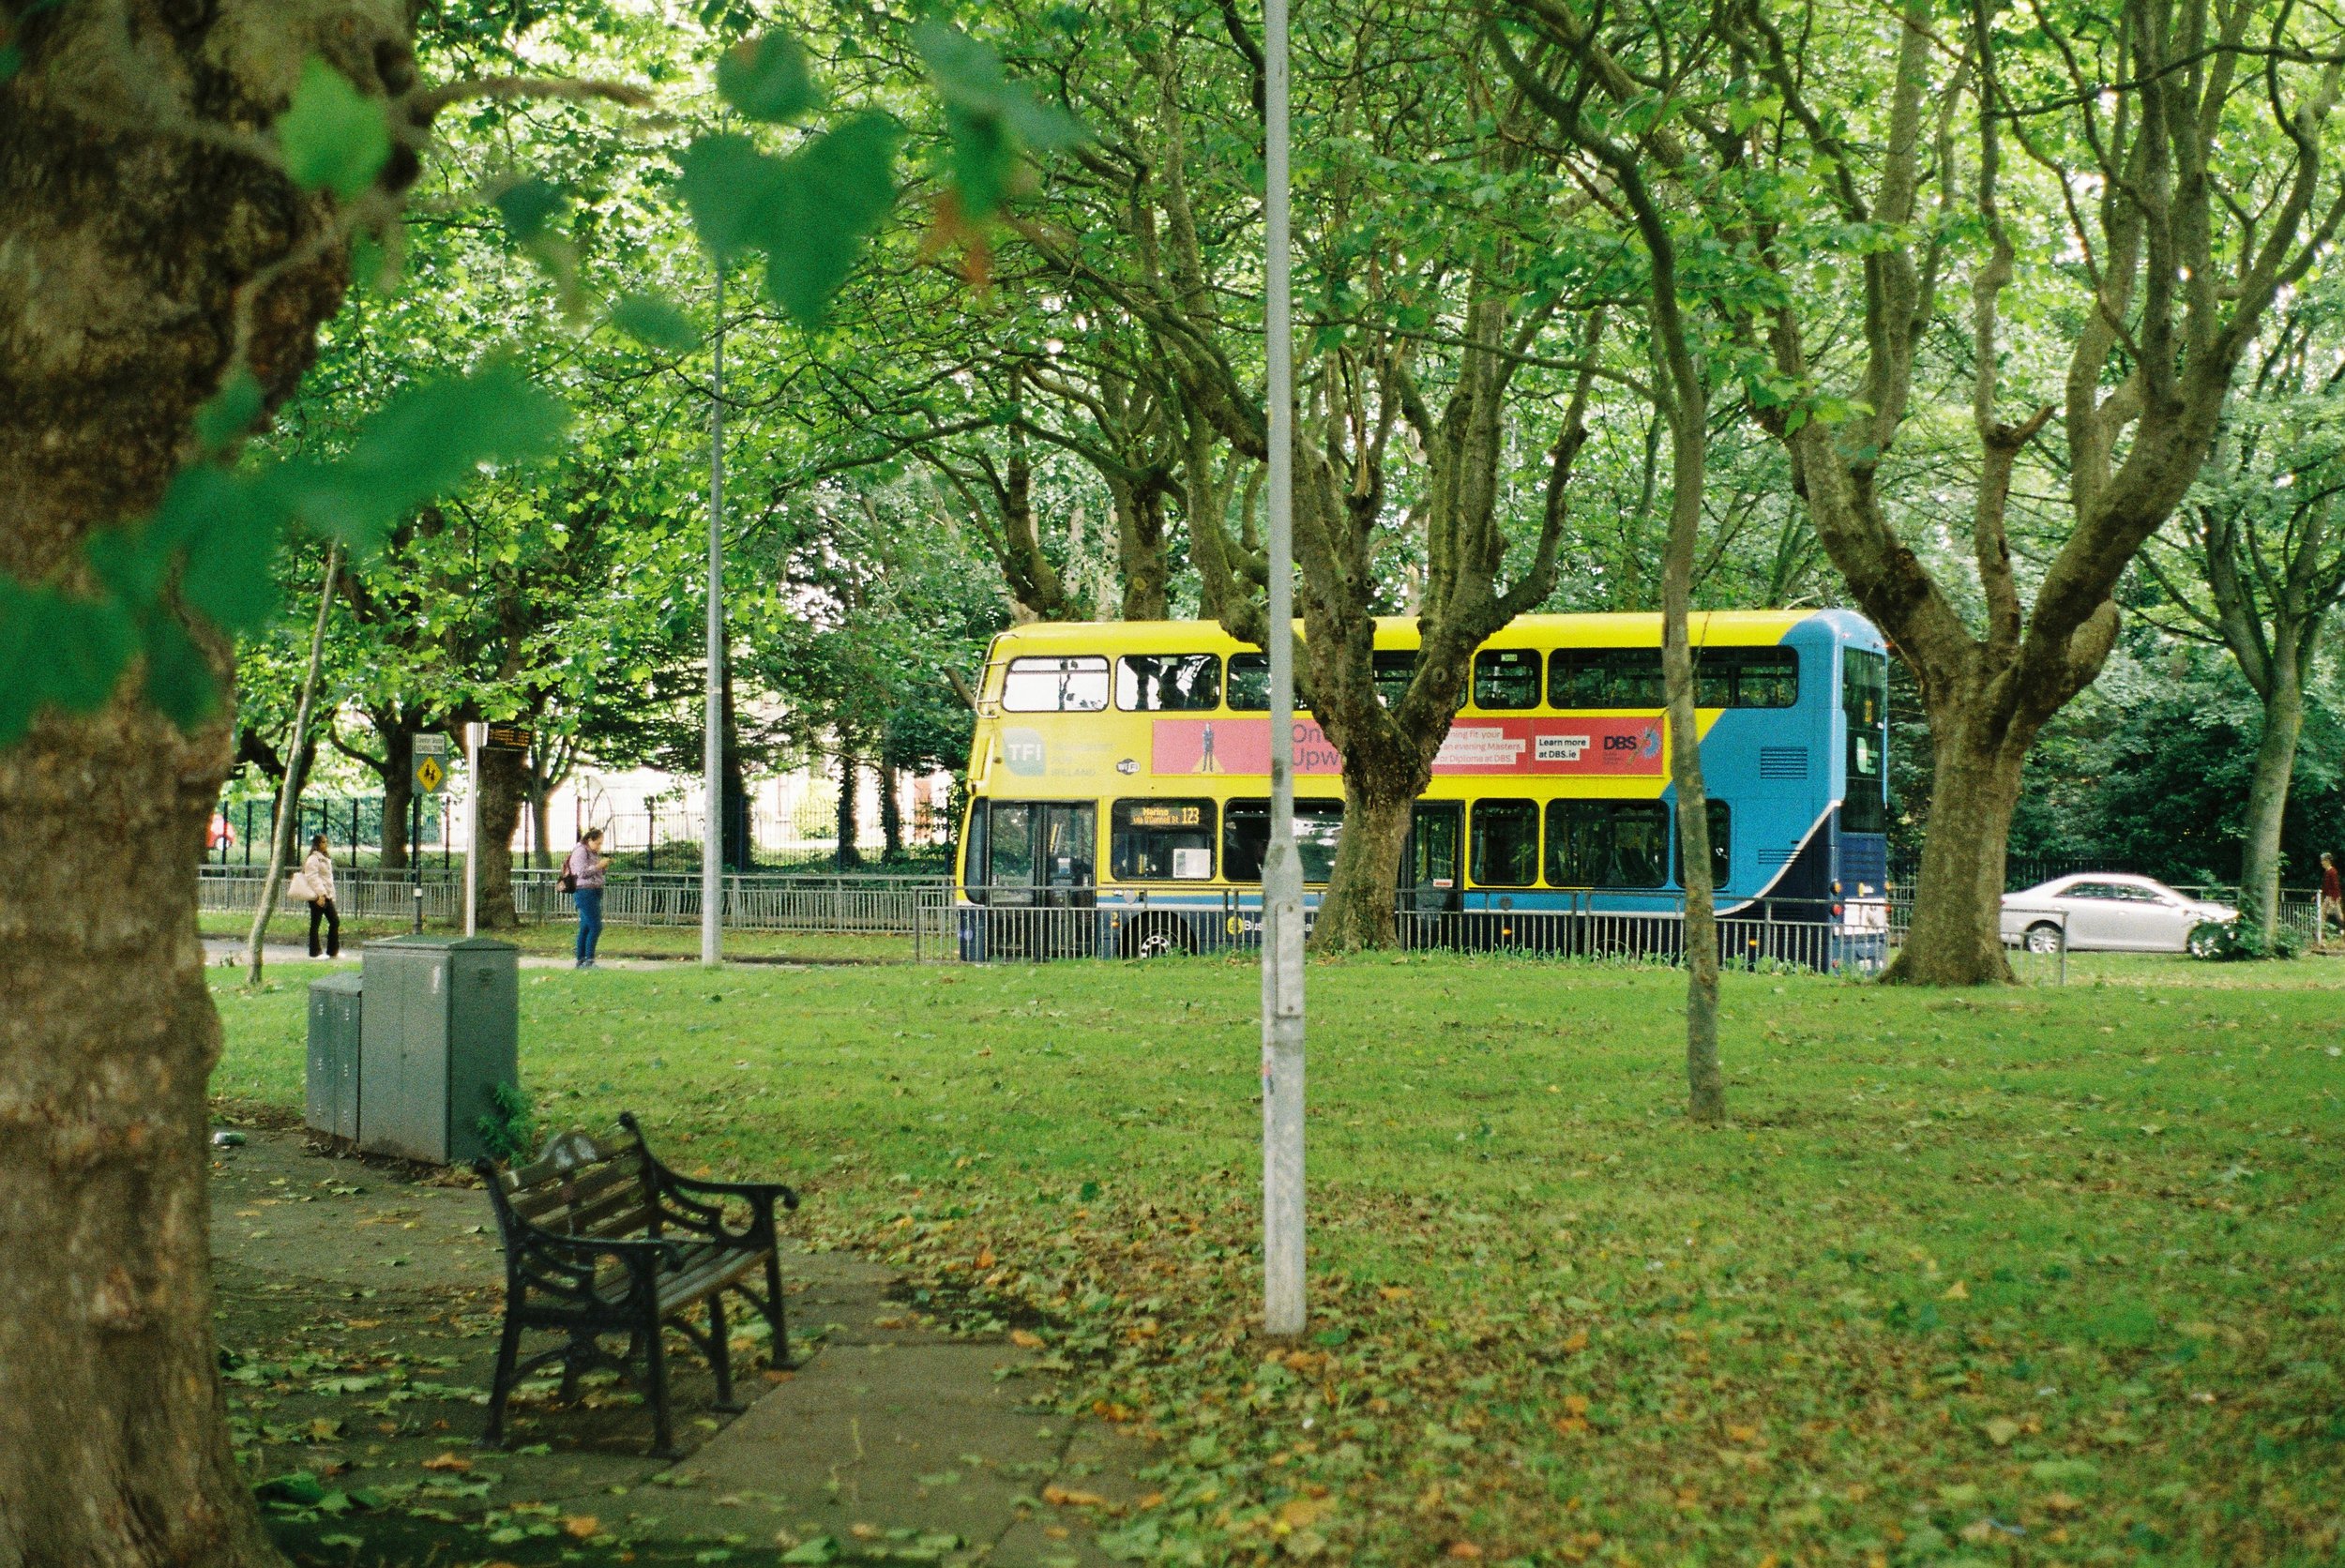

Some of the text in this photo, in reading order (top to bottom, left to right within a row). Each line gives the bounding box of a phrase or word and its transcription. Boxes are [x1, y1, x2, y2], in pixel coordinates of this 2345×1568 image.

[1293, 724, 1323, 743] On
[1469, 730, 1478, 738] fit
[1481, 731, 1500, 740] your
[1454, 743, 1487, 752] evening
[1538, 738, 1564, 746] Learn
[1604, 735, 1637, 750] DBS
[1008, 744, 1041, 761] TFI
[1449, 754, 1483, 763] Diploma
[1538, 750, 1577, 759] at DBS.ie
[1292, 748, 1339, 771] Upw
[1142, 807, 1200, 824] Marino 123
